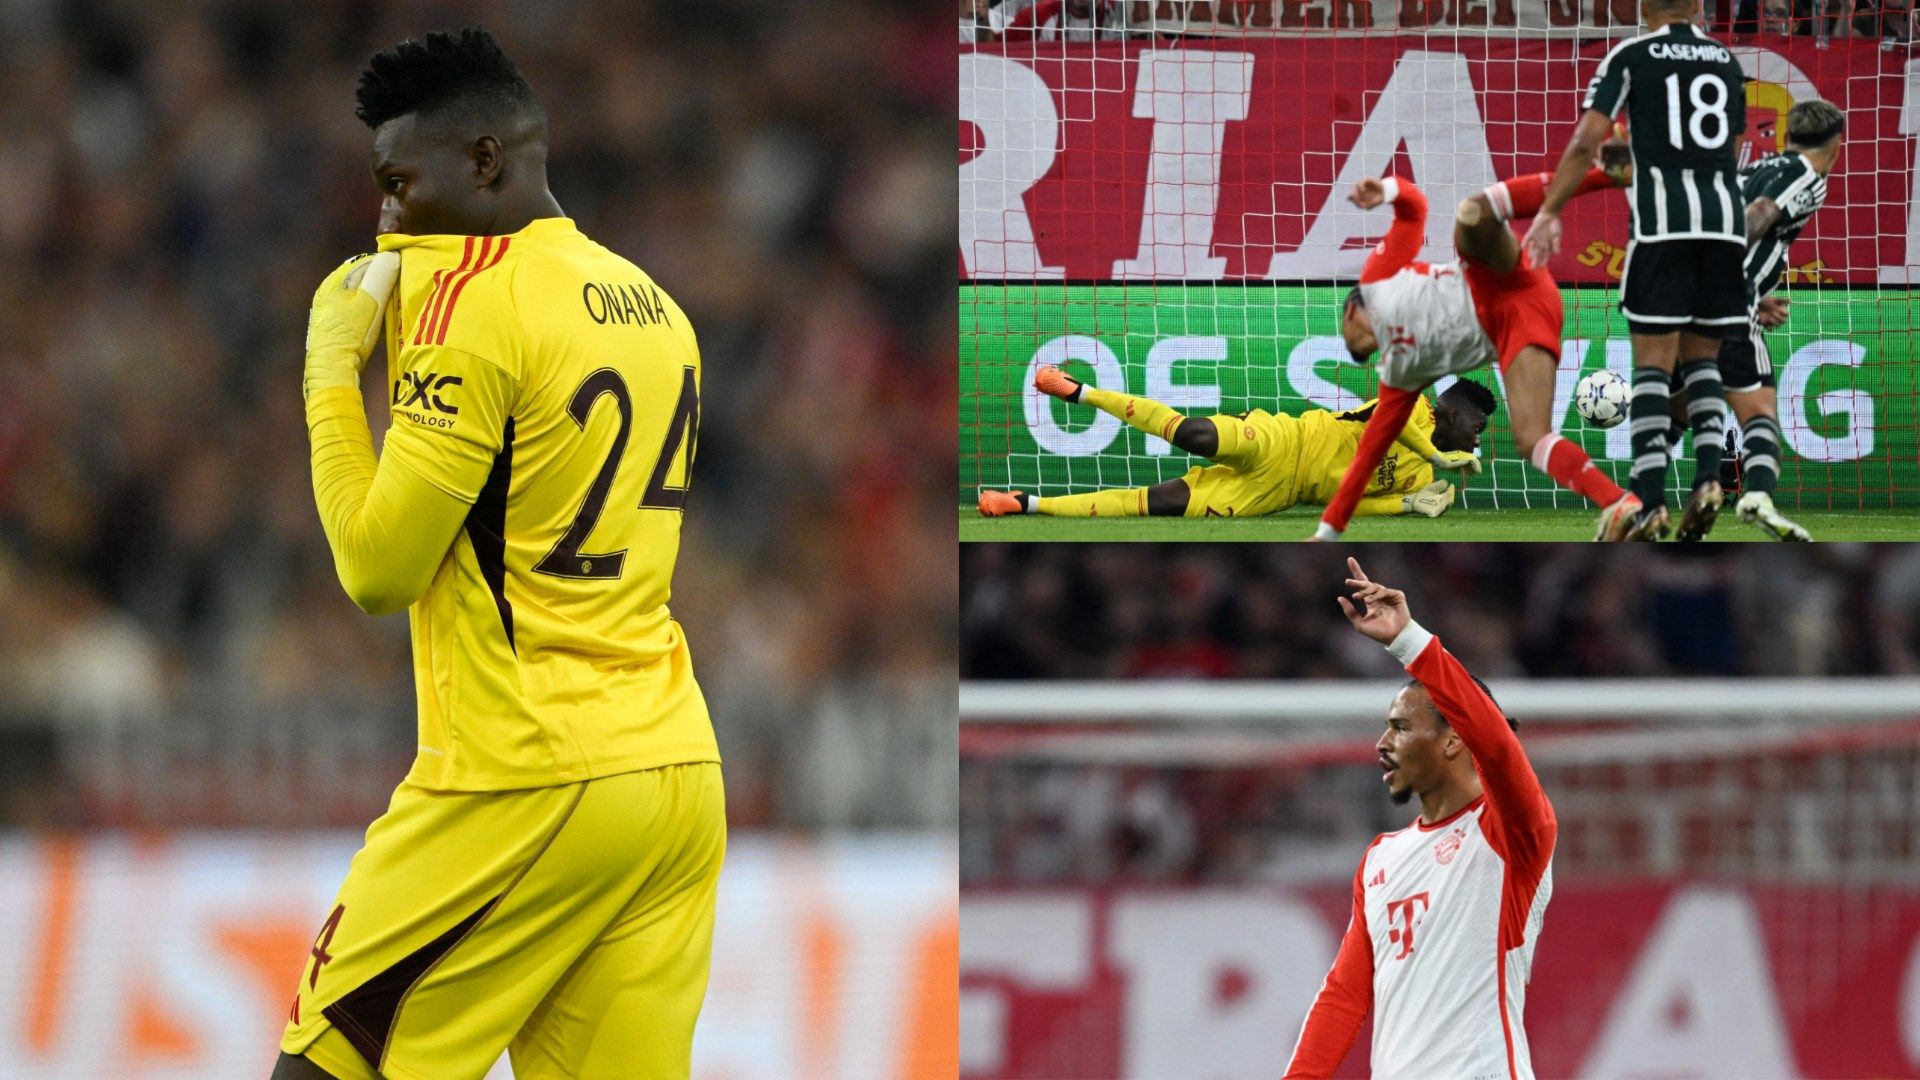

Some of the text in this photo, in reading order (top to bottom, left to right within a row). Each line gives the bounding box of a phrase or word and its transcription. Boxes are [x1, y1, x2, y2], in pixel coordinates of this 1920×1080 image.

[1648, 42, 1731, 64] CASEMIRO
[1664, 72, 1730, 151] 18
[582, 282, 674, 331] ONANA
[392, 371, 463, 415] DXC
[392, 409, 455, 429] NOLOGY
[1022, 335, 1228, 456] OF
[531, 365, 701, 580] 24
[309, 902, 346, 994] 4
